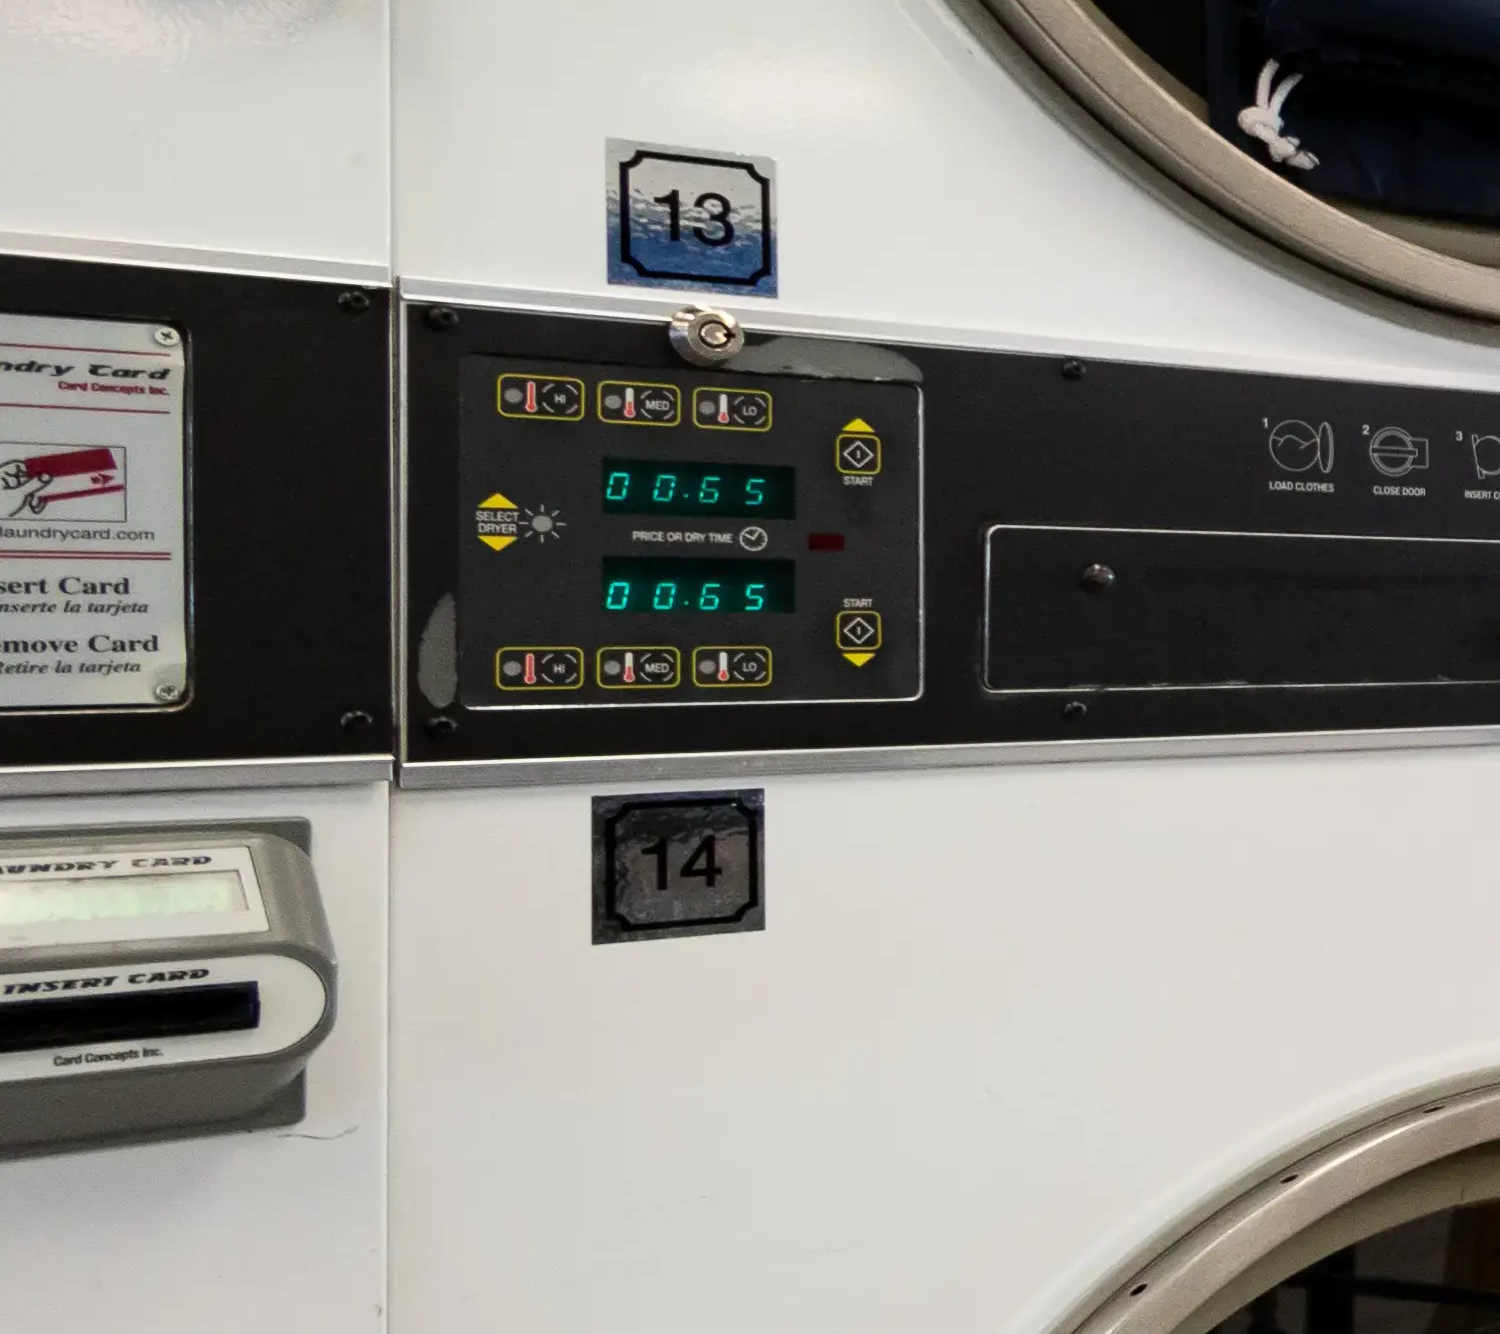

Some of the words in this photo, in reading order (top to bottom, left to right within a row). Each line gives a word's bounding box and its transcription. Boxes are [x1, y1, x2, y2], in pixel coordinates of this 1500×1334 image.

[653, 189, 735, 247] 13
[88, 363, 171, 380] Card
[58, 381, 87, 391] Card
[91, 382, 145, 395] Concepts
[553, 393, 567, 405] HI
[645, 399, 669, 412] MED
[742, 405, 757, 417] LO
[1262, 417, 1269, 428] 1
[1361, 424, 1370, 435] 2
[1455, 430, 1464, 442] 3
[842, 475, 875, 487] START
[1268, 481, 1294, 491] LOAD
[1295, 482, 1335, 493] CLOTHES
[1373, 485, 1401, 496] CLOSE
[1402, 486, 1426, 497] DOOR
[1464, 490, 1491, 500] INSERT
[476, 510, 519, 523] SELECT
[477, 522, 518, 536] DRYER
[632, 530, 664, 543] PRICE
[665, 532, 683, 543] OR
[684, 532, 708, 544] DRY
[709, 533, 733, 545] TIME
[58, 575, 130, 595] Card
[63, 600, 82, 614] la
[87, 600, 149, 616] tarjeta
[842, 598, 873, 609] START
[0, 639, 78, 653] move
[88, 634, 159, 653] Card
[54, 660, 73, 674] la
[78, 660, 142, 676] tarjeta
[553, 663, 566, 674] HI
[645, 662, 669, 674] MED
[742, 661, 757, 673] LO
[131, 855, 213, 868] CARD
[641, 834, 723, 891] 14
[3, 975, 119, 996] INSERT
[127, 968, 210, 985] CARD
[53, 1053, 83, 1067] Card
[85, 1049, 140, 1064] Concepts
[142, 1046, 164, 1058] Inc.
